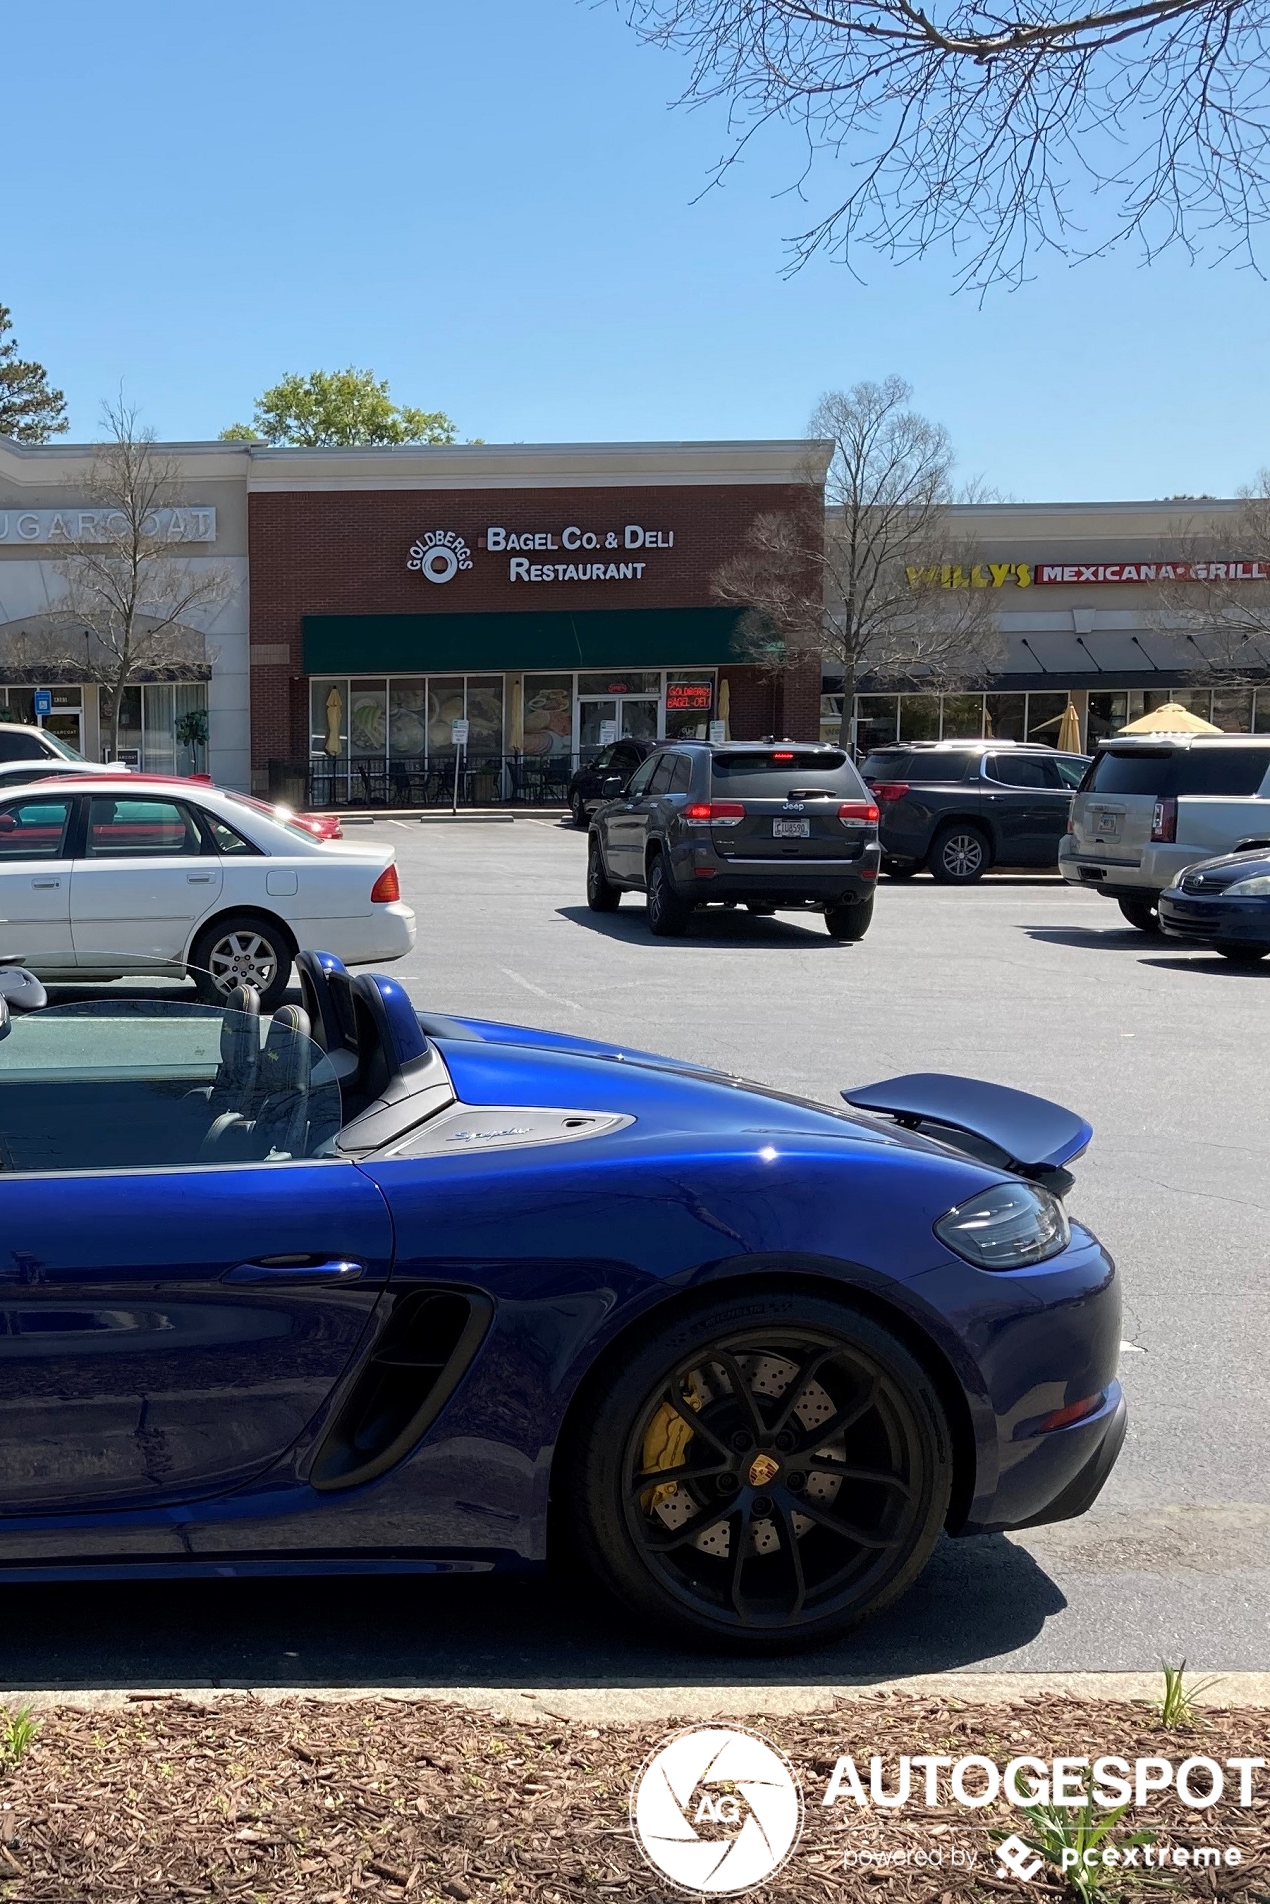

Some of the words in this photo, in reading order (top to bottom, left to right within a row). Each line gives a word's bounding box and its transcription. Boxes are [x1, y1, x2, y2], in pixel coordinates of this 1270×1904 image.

[406, 530, 474, 571] GOLDBERGS
[487, 527, 559, 551] BAGEL
[604, 532, 619, 549] &
[624, 525, 674, 549] DELI
[509, 557, 646, 582] RESTAURANT
[905, 563, 1031, 589] WILLY'S
[1042, 565, 1176, 582] MEXICANA
[1190, 563, 1267, 580] GRILL
[782, 803, 805, 812] Jeep
